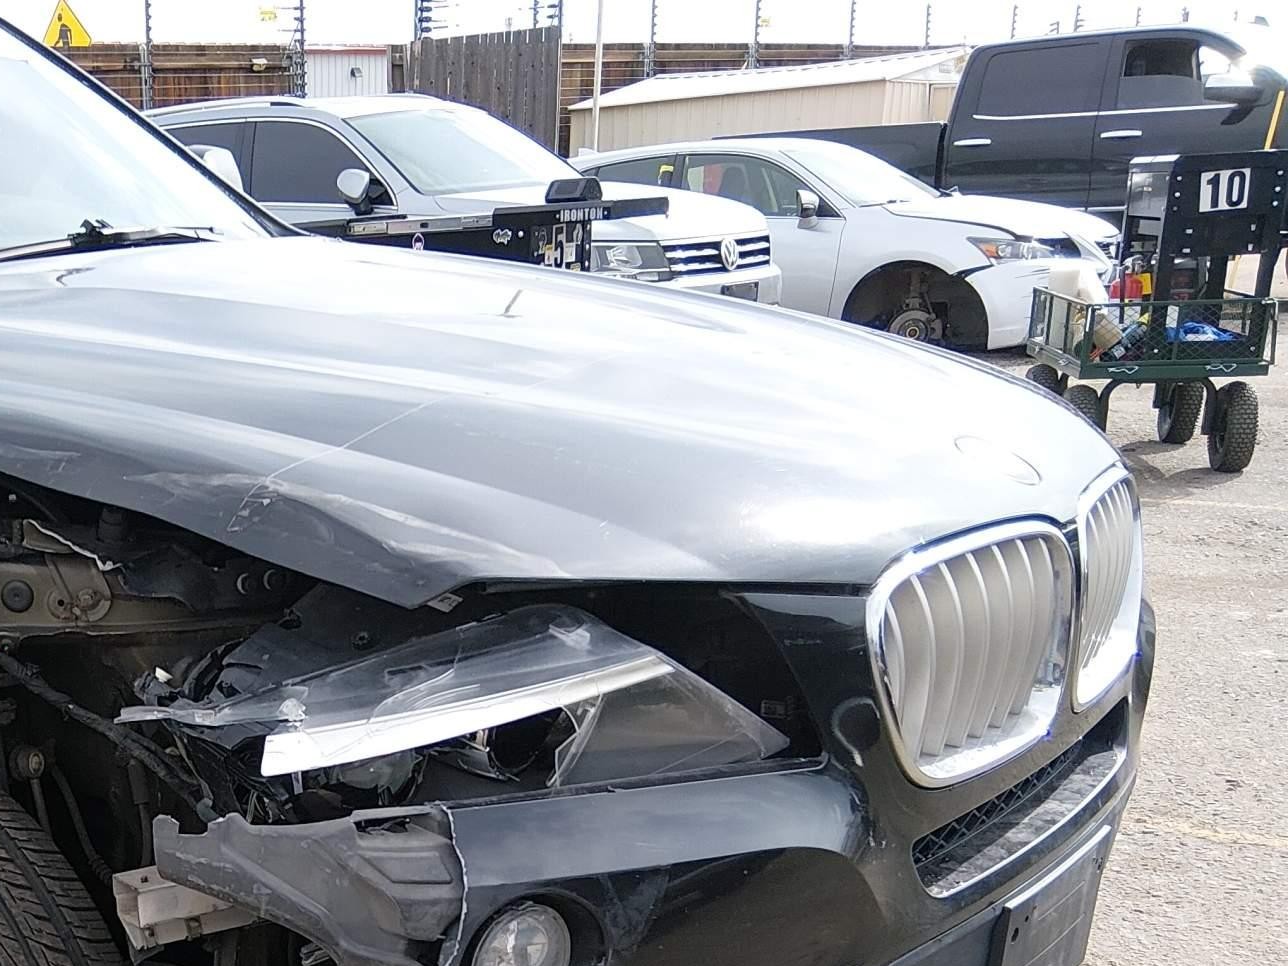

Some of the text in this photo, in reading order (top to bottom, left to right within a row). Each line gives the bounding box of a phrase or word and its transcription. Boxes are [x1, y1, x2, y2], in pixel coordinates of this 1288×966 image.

[1206, 170, 1247, 209] 10
[559, 207, 604, 223] IRONTON
[553, 225, 565, 269] 5
